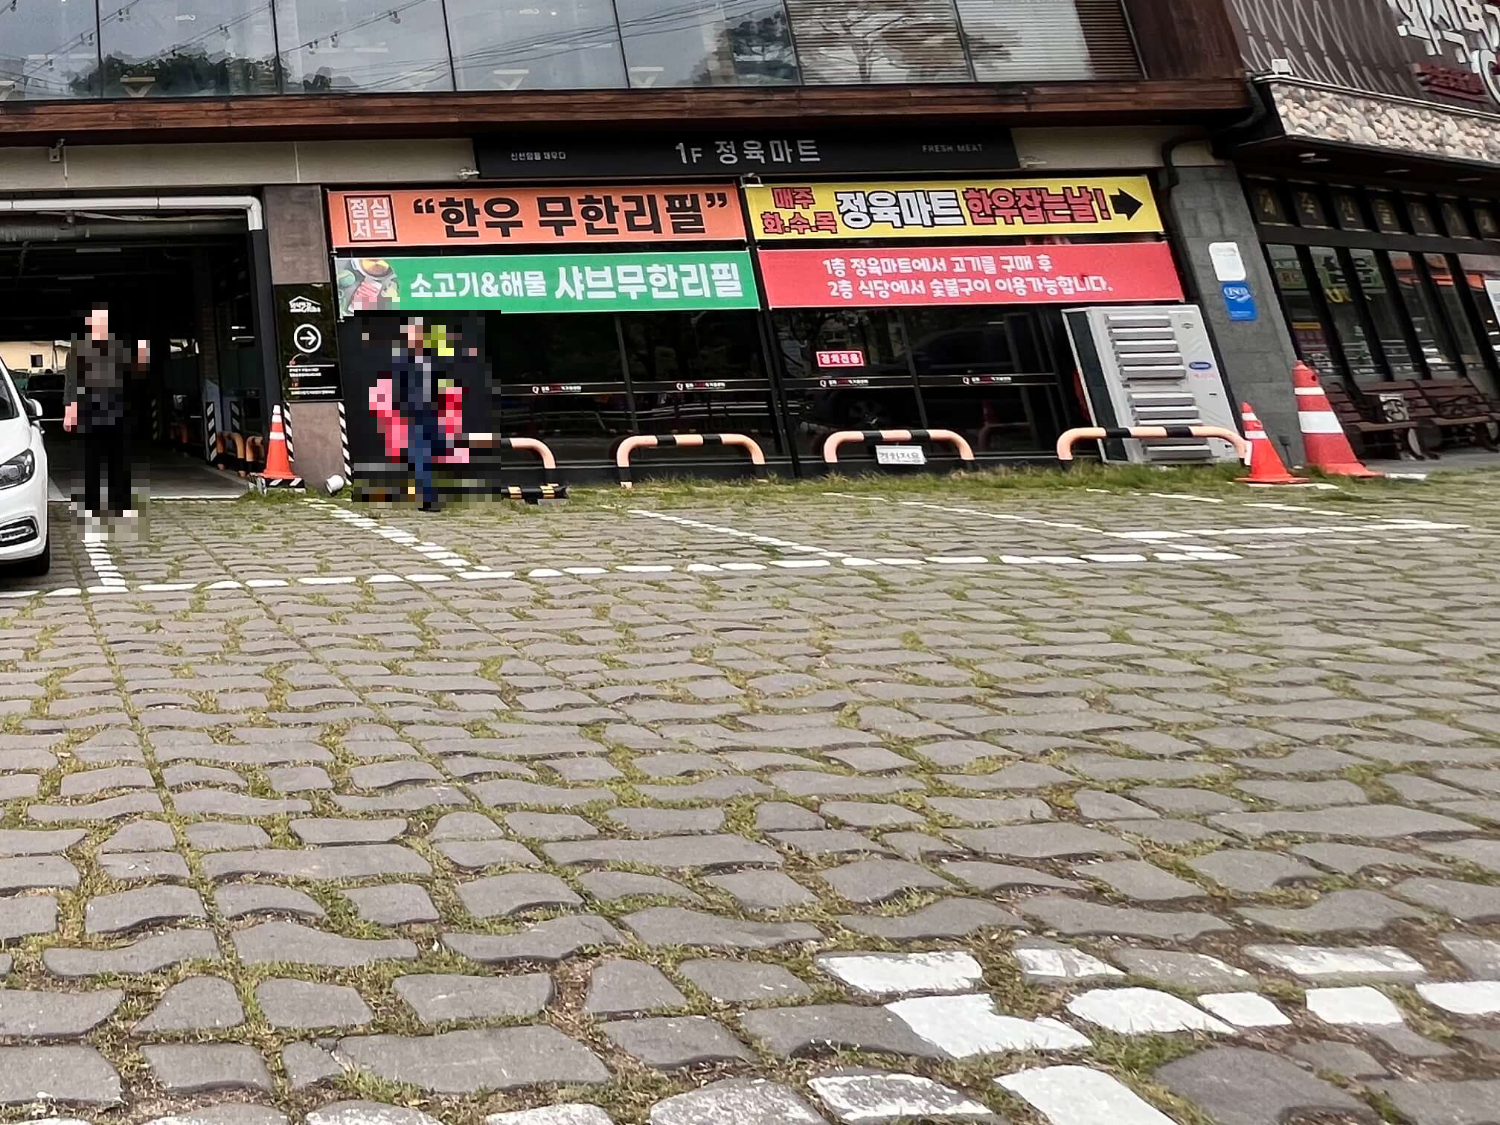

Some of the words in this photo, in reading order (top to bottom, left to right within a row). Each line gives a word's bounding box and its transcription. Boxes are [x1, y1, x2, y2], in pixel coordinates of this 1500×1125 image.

[675, 142, 702, 164] 1F
[715, 139, 822, 164] 정육마트
[922, 144, 954, 153] FRESH
[957, 143, 983, 153] MEAT
[350, 198, 389, 218] 점심
[772, 187, 816, 209] 매주
[834, 189, 967, 229] 정육마트
[352, 218, 394, 238] 저녁
[822, 258, 846, 277] 1층
[850, 256, 947, 277] 정육마트에서
[951, 255, 998, 275] 고기를
[1001, 255, 1034, 272] 구매
[1038, 253, 1053, 271] 후
[410, 270, 547, 298] 소고기&해물
[555, 263, 744, 300] 샤브무한리필
[827, 280, 854, 299] 2층
[858, 279, 926, 299] 식당에서
[929, 278, 991, 298] 숯불구이
[995, 276, 1114, 297] 이용가능합니다.
